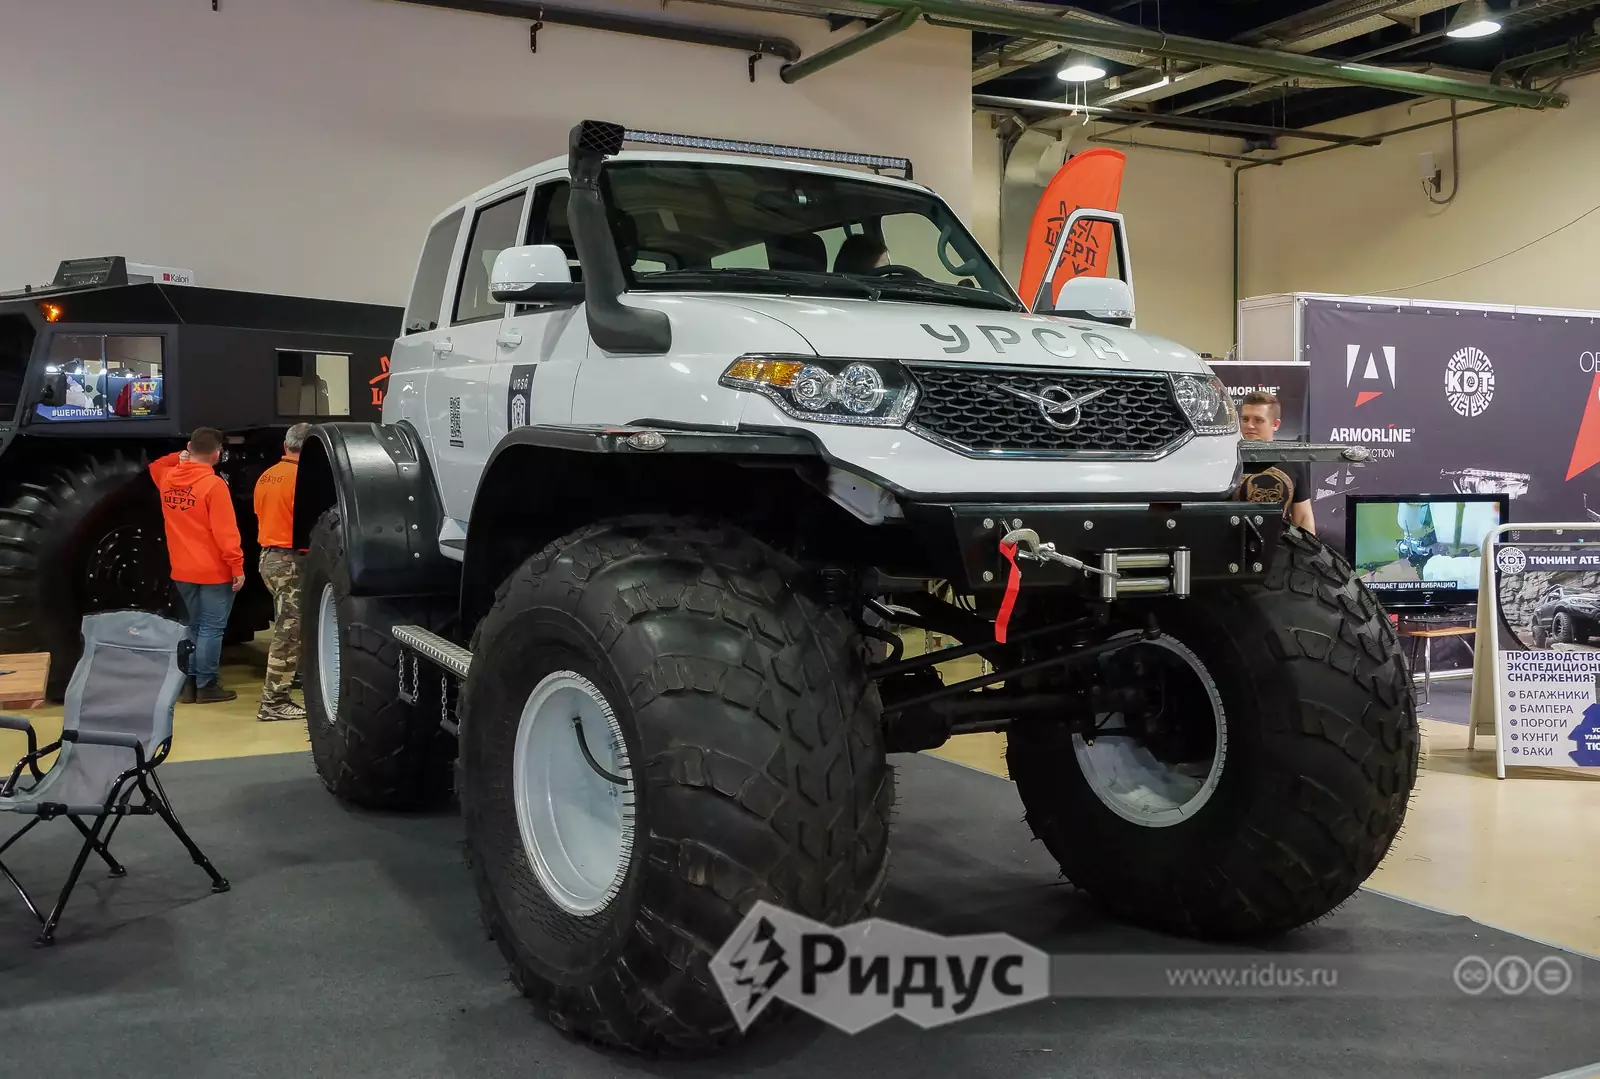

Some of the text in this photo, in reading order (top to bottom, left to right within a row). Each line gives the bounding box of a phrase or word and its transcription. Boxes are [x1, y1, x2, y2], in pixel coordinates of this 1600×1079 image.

[52, 408, 103, 417] #ШЕРПКЛУБ
[164, 495, 196, 507] ШЕРП
[1529, 556, 1577, 565] ТЮНИНГ
[1508, 673, 1595, 682] СНАРЯЖЕНИЯ:
[1519, 690, 1590, 700] БАГАЖНИКИ
[1520, 704, 1574, 714] БАМПЕРА
[1521, 718, 1568, 728] ПОРОГИ
[1522, 732, 1559, 742] КУНГИ
[1523, 746, 1553, 756] БАКИ
